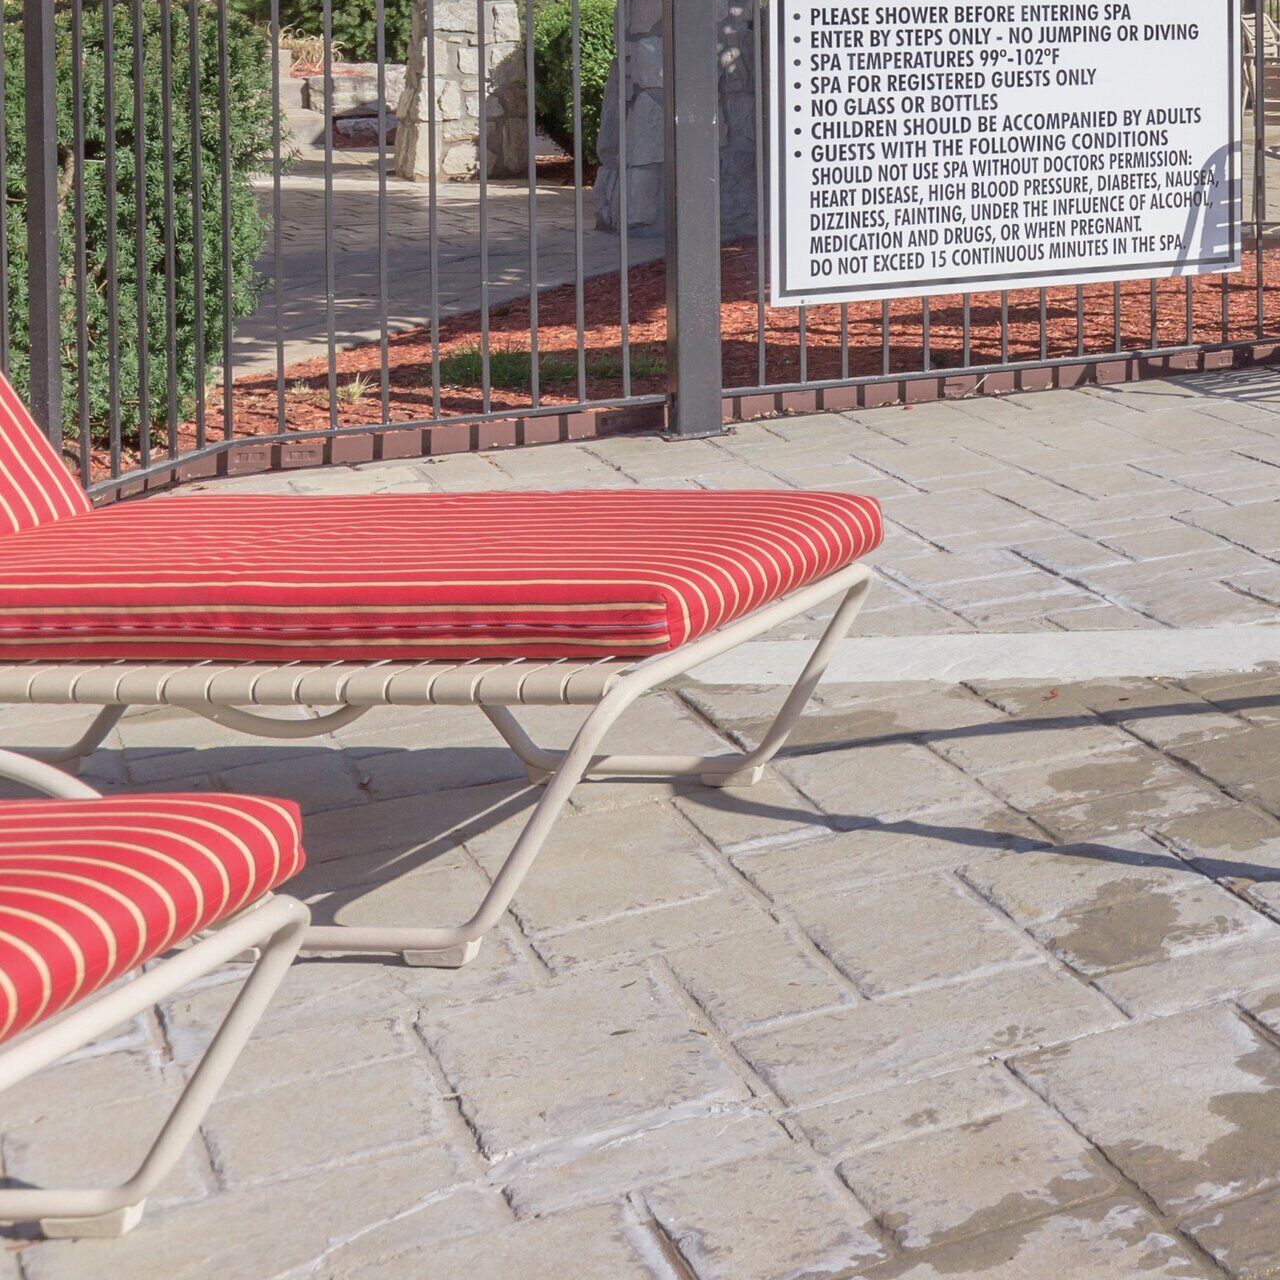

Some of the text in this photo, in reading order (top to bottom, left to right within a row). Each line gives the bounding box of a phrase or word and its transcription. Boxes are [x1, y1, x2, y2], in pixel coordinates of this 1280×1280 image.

[810, 3, 1131, 26] PLEASE SHOWER BEFORE ENTERING SPA
[811, 30, 864, 49] ENTER
[870, 29, 891, 47] BY
[896, 28, 943, 47] STEPS
[949, 27, 992, 45] ONLY
[1009, 27, 1033, 44] NO
[1038, 25, 1112, 44] JUMPING
[1117, 25, 1139, 42] OR
[1144, 23, 1199, 41] DIVING
[810, 53, 842, 72] SPA
[847, 50, 974, 70] TEMPERATURES
[810, 68, 1097, 95] SPA FOR REGISTERED GUESTS ONLY
[811, 93, 998, 117] NO GLASS OR BOTTLES
[811, 107, 1202, 140] CHILDREN SHOULD BE ACCOMPANIED BY ADULTS
[811, 129, 1168, 163] GUESTS WITH THE FOLLOWING CONDITIONS
[812, 149, 1192, 186] SHOULD NOT USE SPA WITHOUT DOCTORS PERMISSION:
[810, 170, 1220, 209] HEART DISEASE, HIGH BLOOD PRESSURE, DIABETES, NAUSEA,
[810, 191, 1213, 231] DIZZINESS, FAINTING, UNDER THE INFLUENCE OF ALCOHOL,
[810, 215, 1142, 254] MEDICATION AND DRUGS, OR WHEN PREGNANT.
[810, 234, 1187, 277] DO NOT EXCEED 15 CONTINUOUS MINUTES IN THE SPA.
